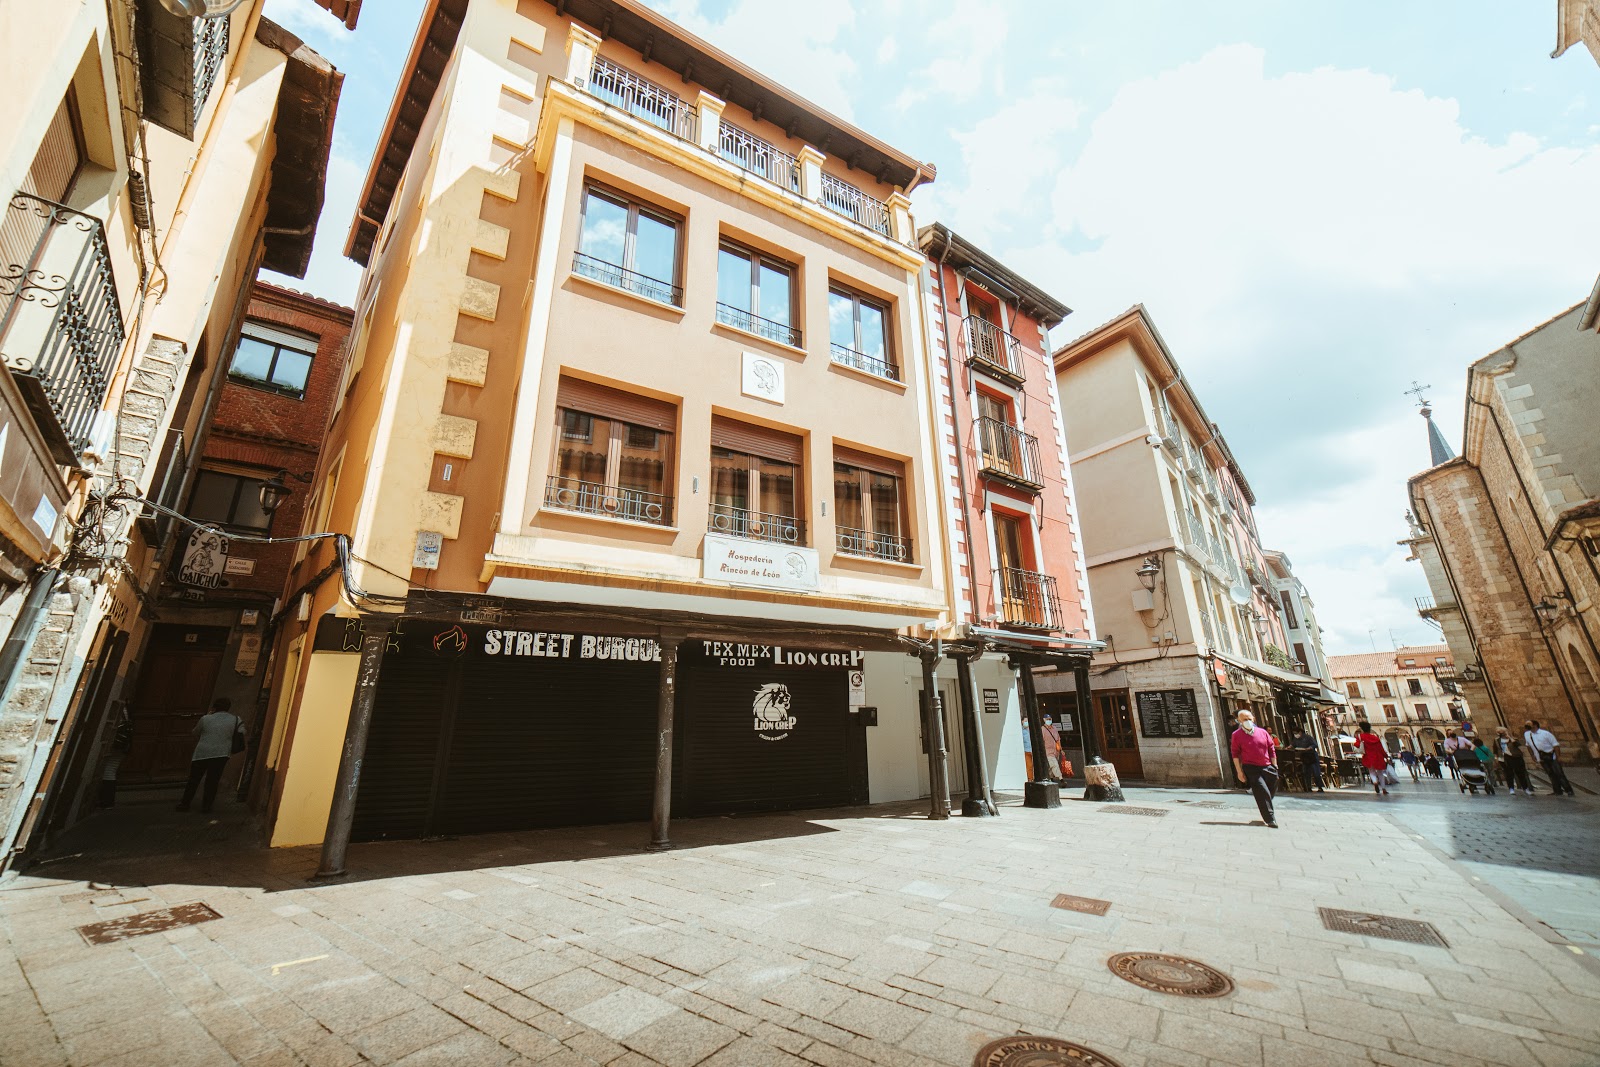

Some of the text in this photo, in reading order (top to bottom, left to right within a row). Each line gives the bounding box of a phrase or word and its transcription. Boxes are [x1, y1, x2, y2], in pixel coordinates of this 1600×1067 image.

[180, 565, 220, 588] GAUCHO
[720, 563, 781, 579] Rincón de León
[183, 589, 205, 600] bar
[484, 629, 678, 662] STREET BURGUE
[703, 640, 771, 658] TEX MEX
[720, 658, 756, 666] FOOD
